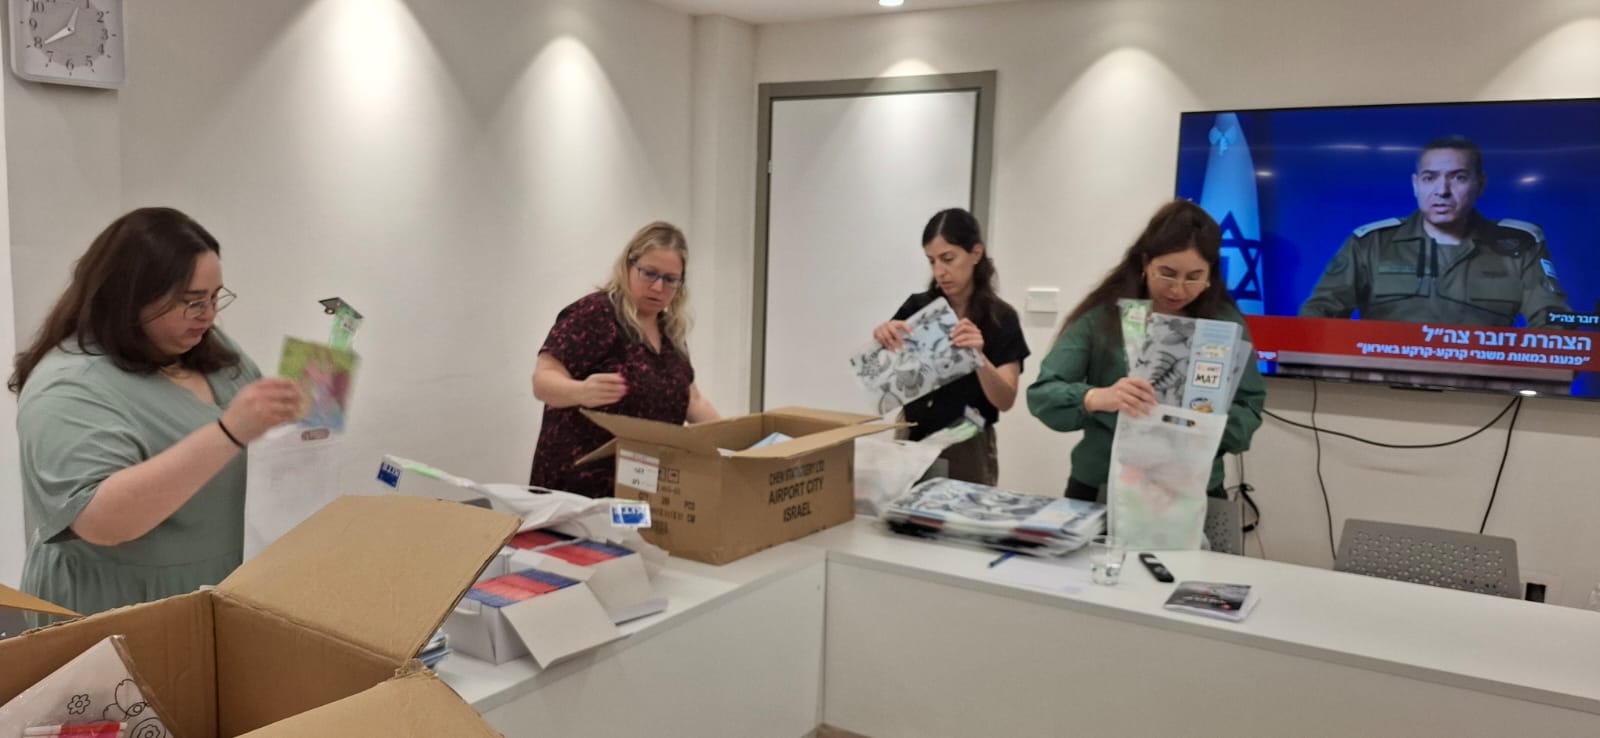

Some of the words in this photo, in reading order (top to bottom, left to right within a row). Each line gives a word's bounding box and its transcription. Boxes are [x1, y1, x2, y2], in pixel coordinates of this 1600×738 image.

[32, 0, 45, 13] 10
[96, 11, 105, 23] 2
[28, 18, 38, 30] 9
[101, 28, 109, 40] 3
[33, 36, 43, 49] 8
[97, 43, 105, 56] 4
[46, 50, 55, 63] 7
[85, 55, 94, 68] 5
[65, 59, 75, 71] 6
[1577, 314, 1599, 324] דובר
[1473, 329, 1518, 347] דובר
[1520, 332, 1592, 351] הצהרת
[1507, 352, 1548, 363] במאות
[1195, 373, 1219, 385] MAT
[768, 481, 805, 506] AIRPORT
[806, 476, 825, 495] CITY
[783, 501, 813, 523] ISRAEL
